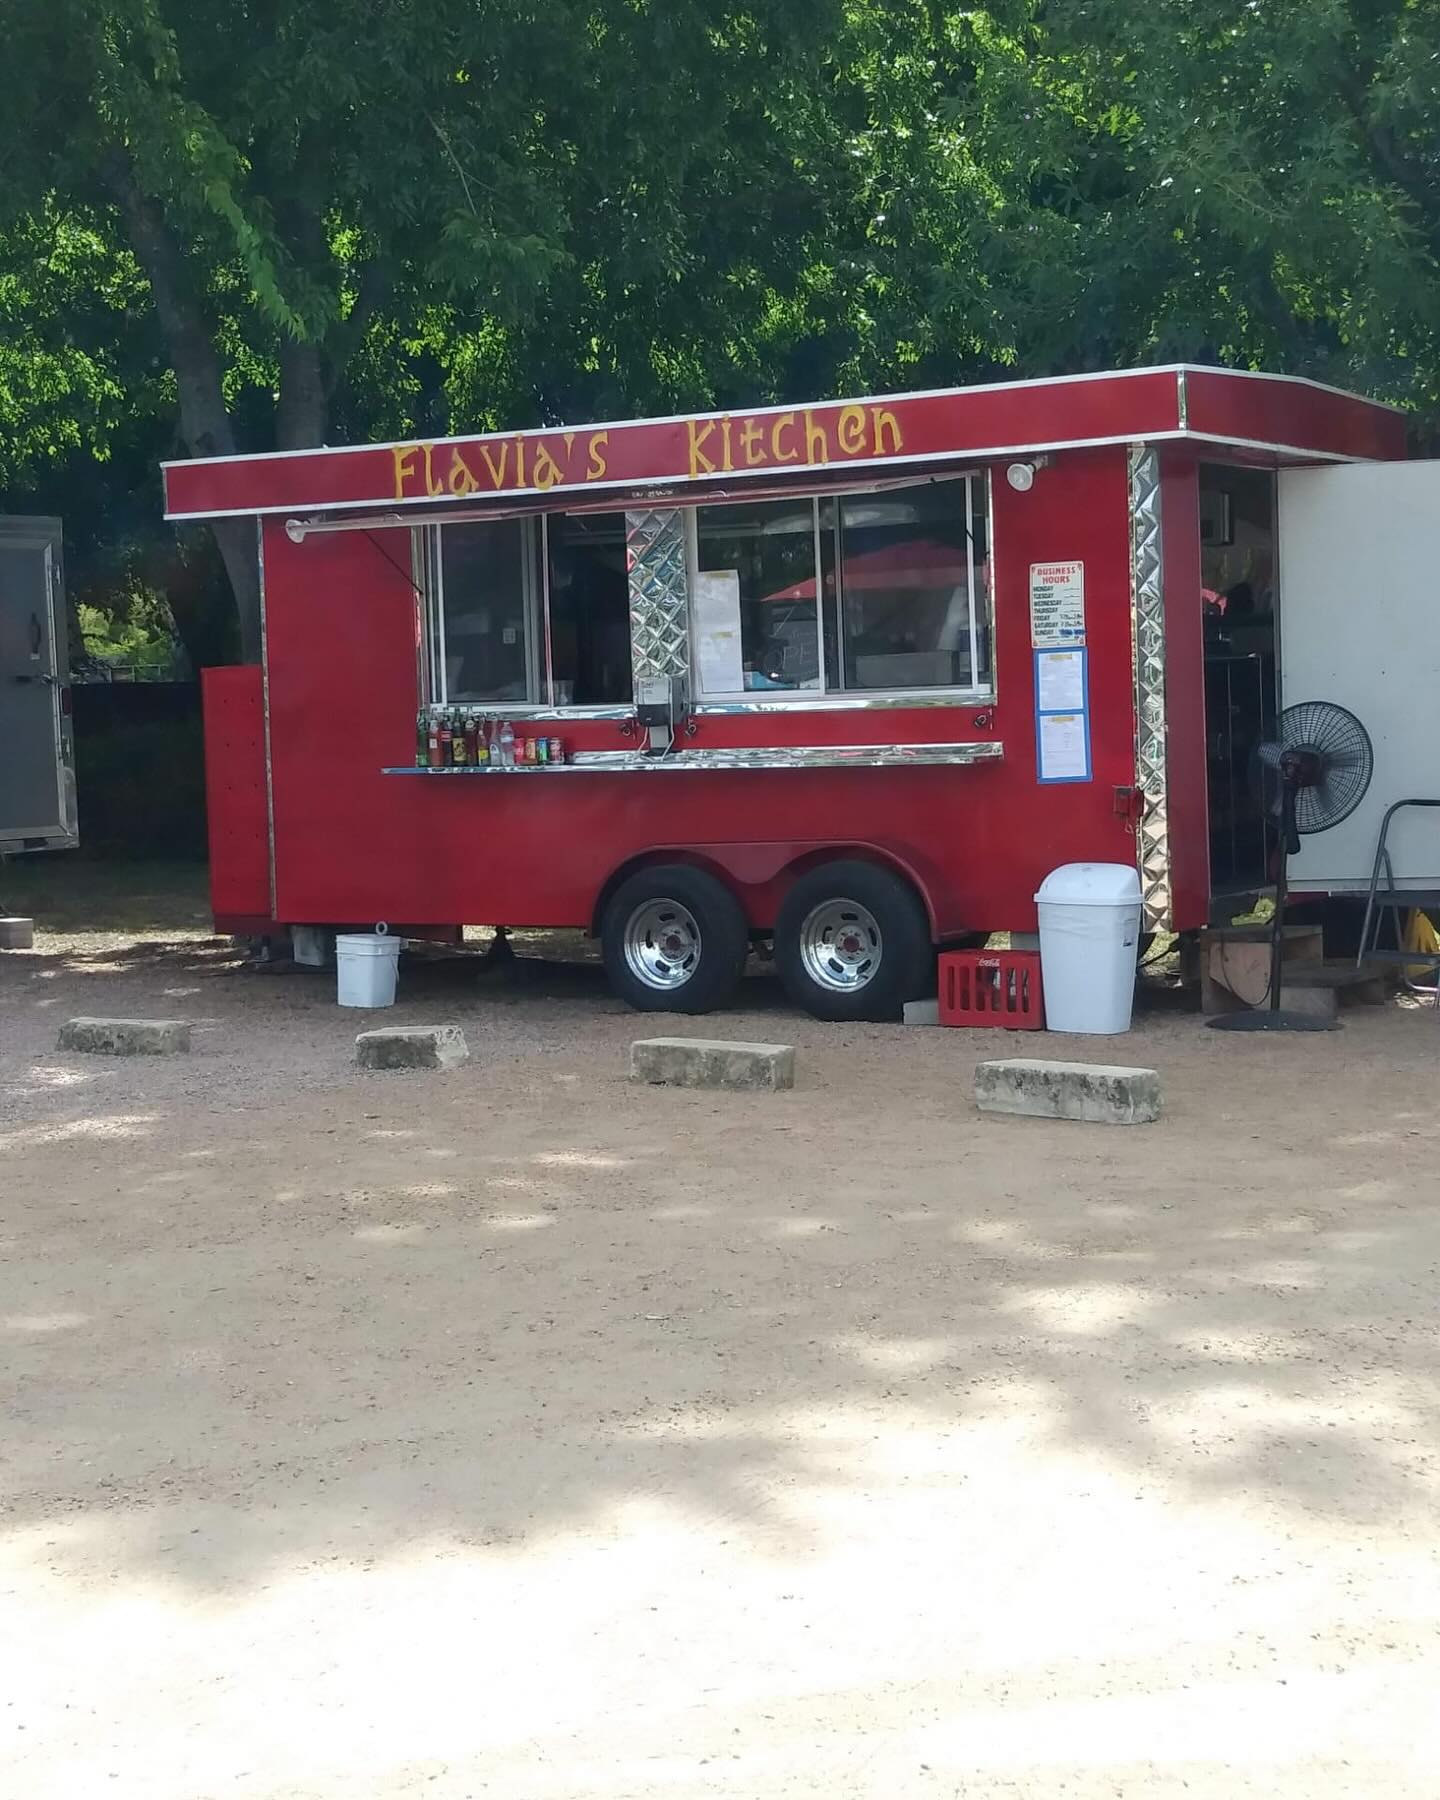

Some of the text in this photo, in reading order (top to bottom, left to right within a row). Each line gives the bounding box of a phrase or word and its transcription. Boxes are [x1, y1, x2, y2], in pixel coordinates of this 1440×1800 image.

[687, 405, 904, 479] Kitchen
[1037, 566, 1076, 576] BUSINESS
[1042, 576, 1071, 584] HOURS
